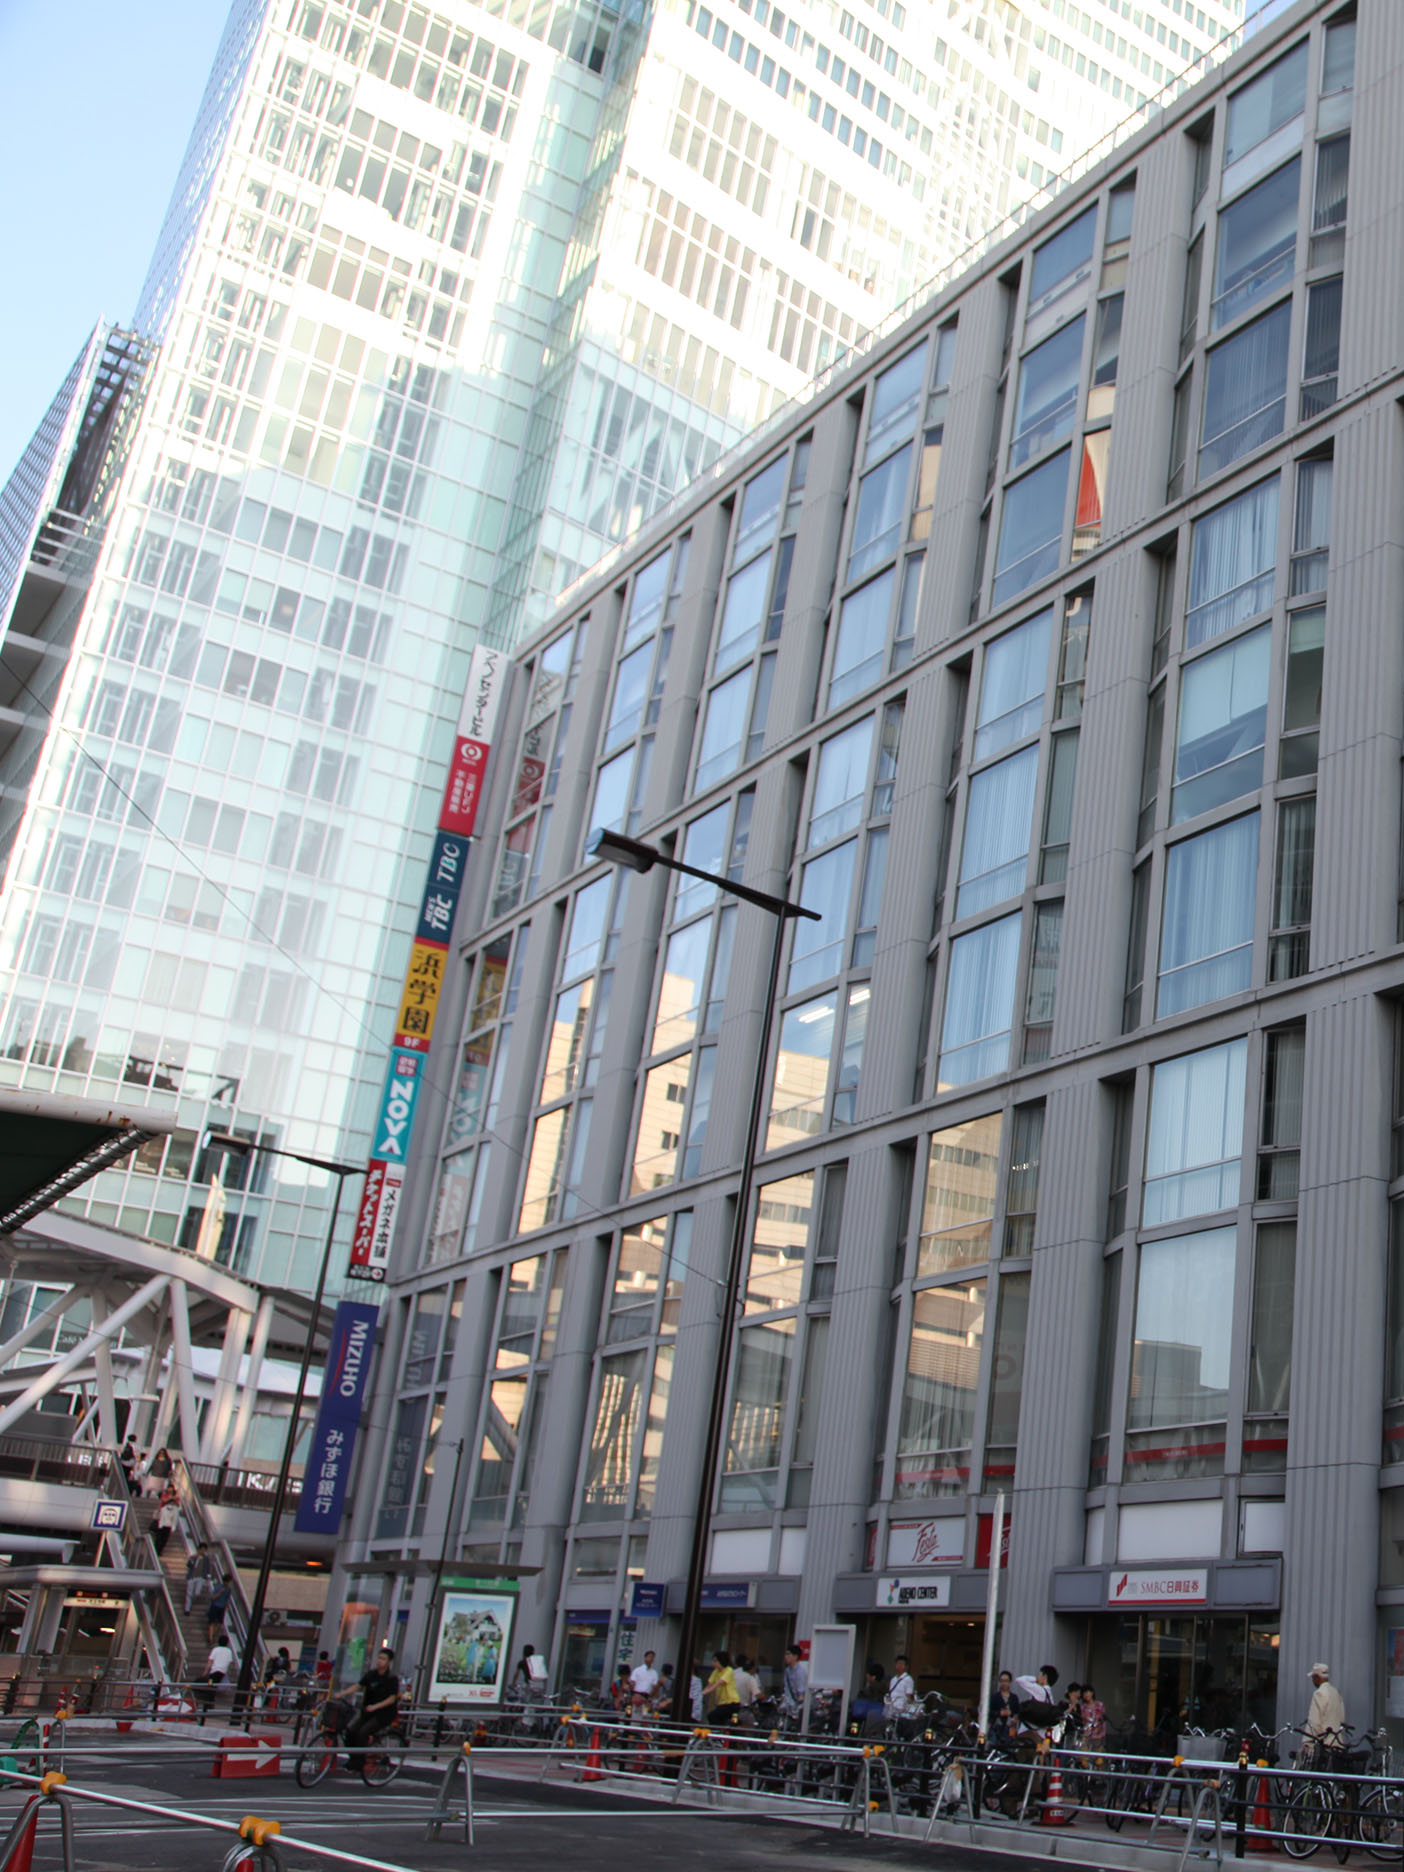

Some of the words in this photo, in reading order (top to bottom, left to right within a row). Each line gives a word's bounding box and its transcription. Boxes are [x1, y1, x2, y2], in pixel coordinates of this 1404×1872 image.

[436, 842, 461, 883] TBC
[431, 893, 454, 931] TBC
[402, 949, 442, 1034] 浜学園
[403, 1036, 421, 1048] 9F
[378, 1079, 414, 1156] NOVA
[340, 1319, 369, 1397] MIZUHO
[313, 1428, 345, 1515] みずほ銀行
[1140, 1579, 1200, 1594] SMBC日興証券
